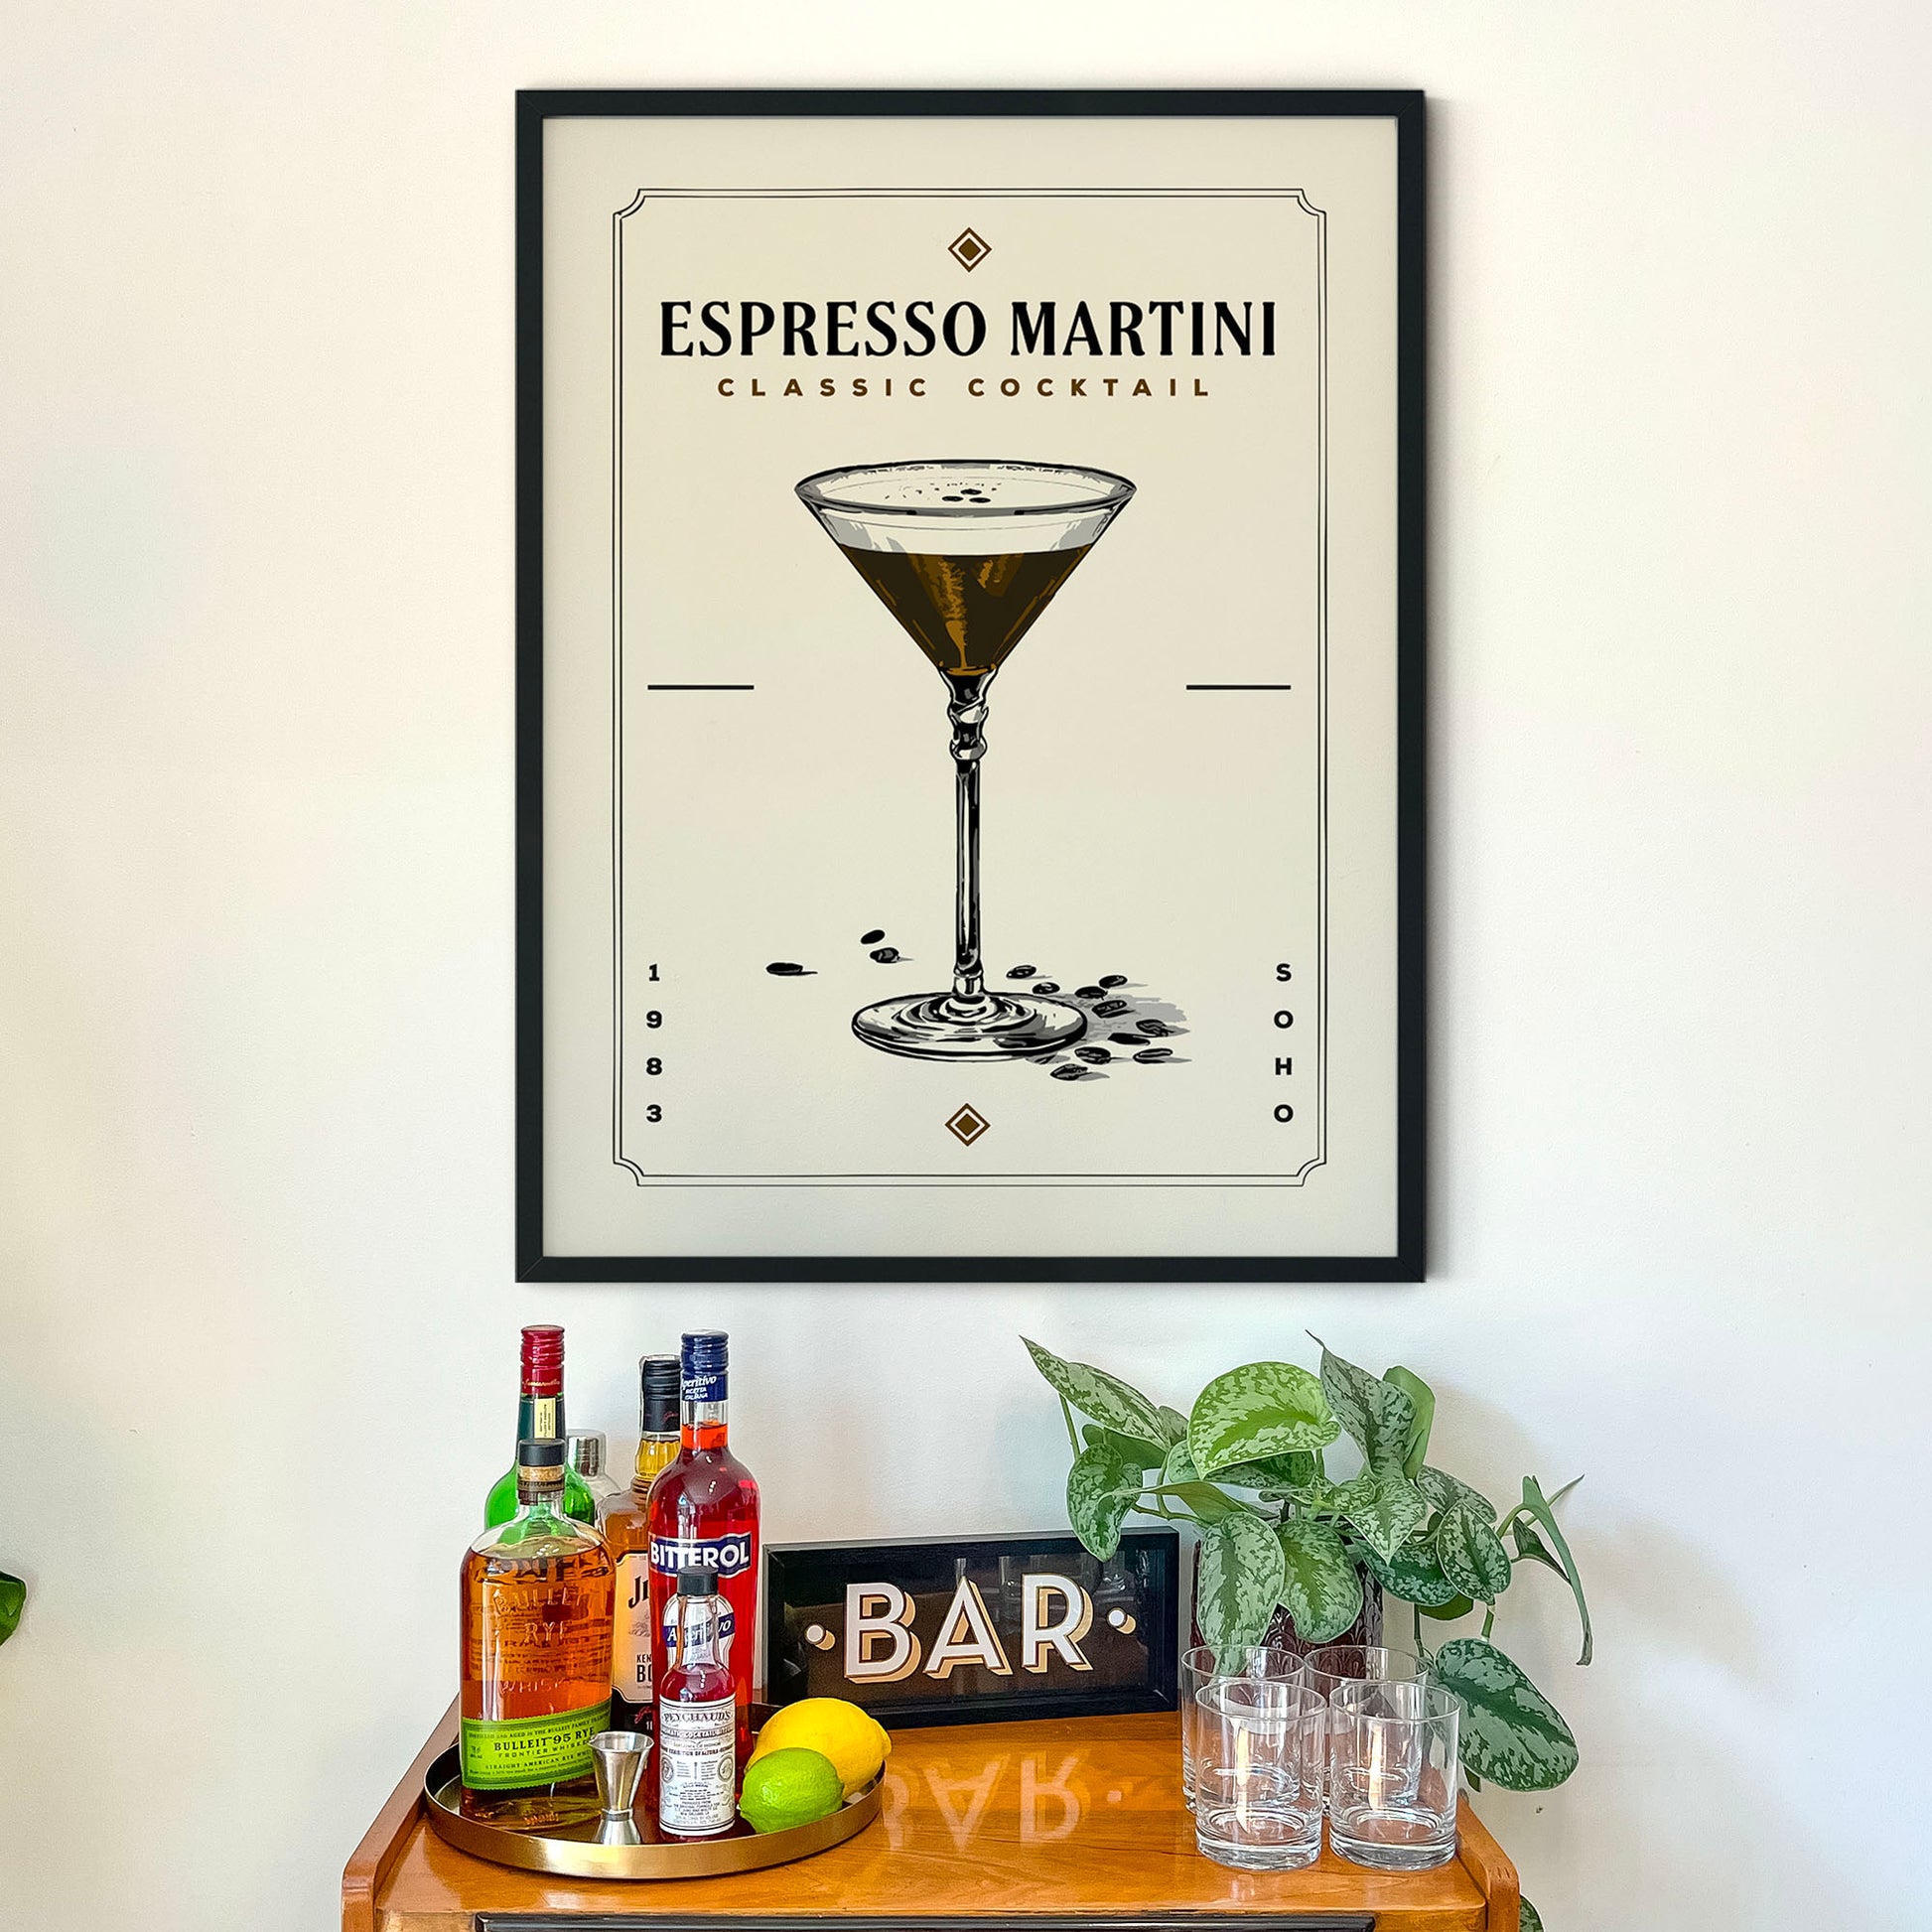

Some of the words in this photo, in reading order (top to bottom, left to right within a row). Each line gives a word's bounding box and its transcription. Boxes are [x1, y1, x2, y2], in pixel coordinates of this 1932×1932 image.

[660, 300, 987, 357] ESPRESSO
[1010, 300, 1276, 357] MARTINI
[717, 377, 926, 397] CLASSIC
[968, 377, 1208, 397] COCKTAIL
[650, 1541, 749, 1569] BITTEROL
[845, 1573, 1093, 1684] BAR
[553, 1732, 572, 1744] 95
[576, 1725, 595, 1740] RYE
